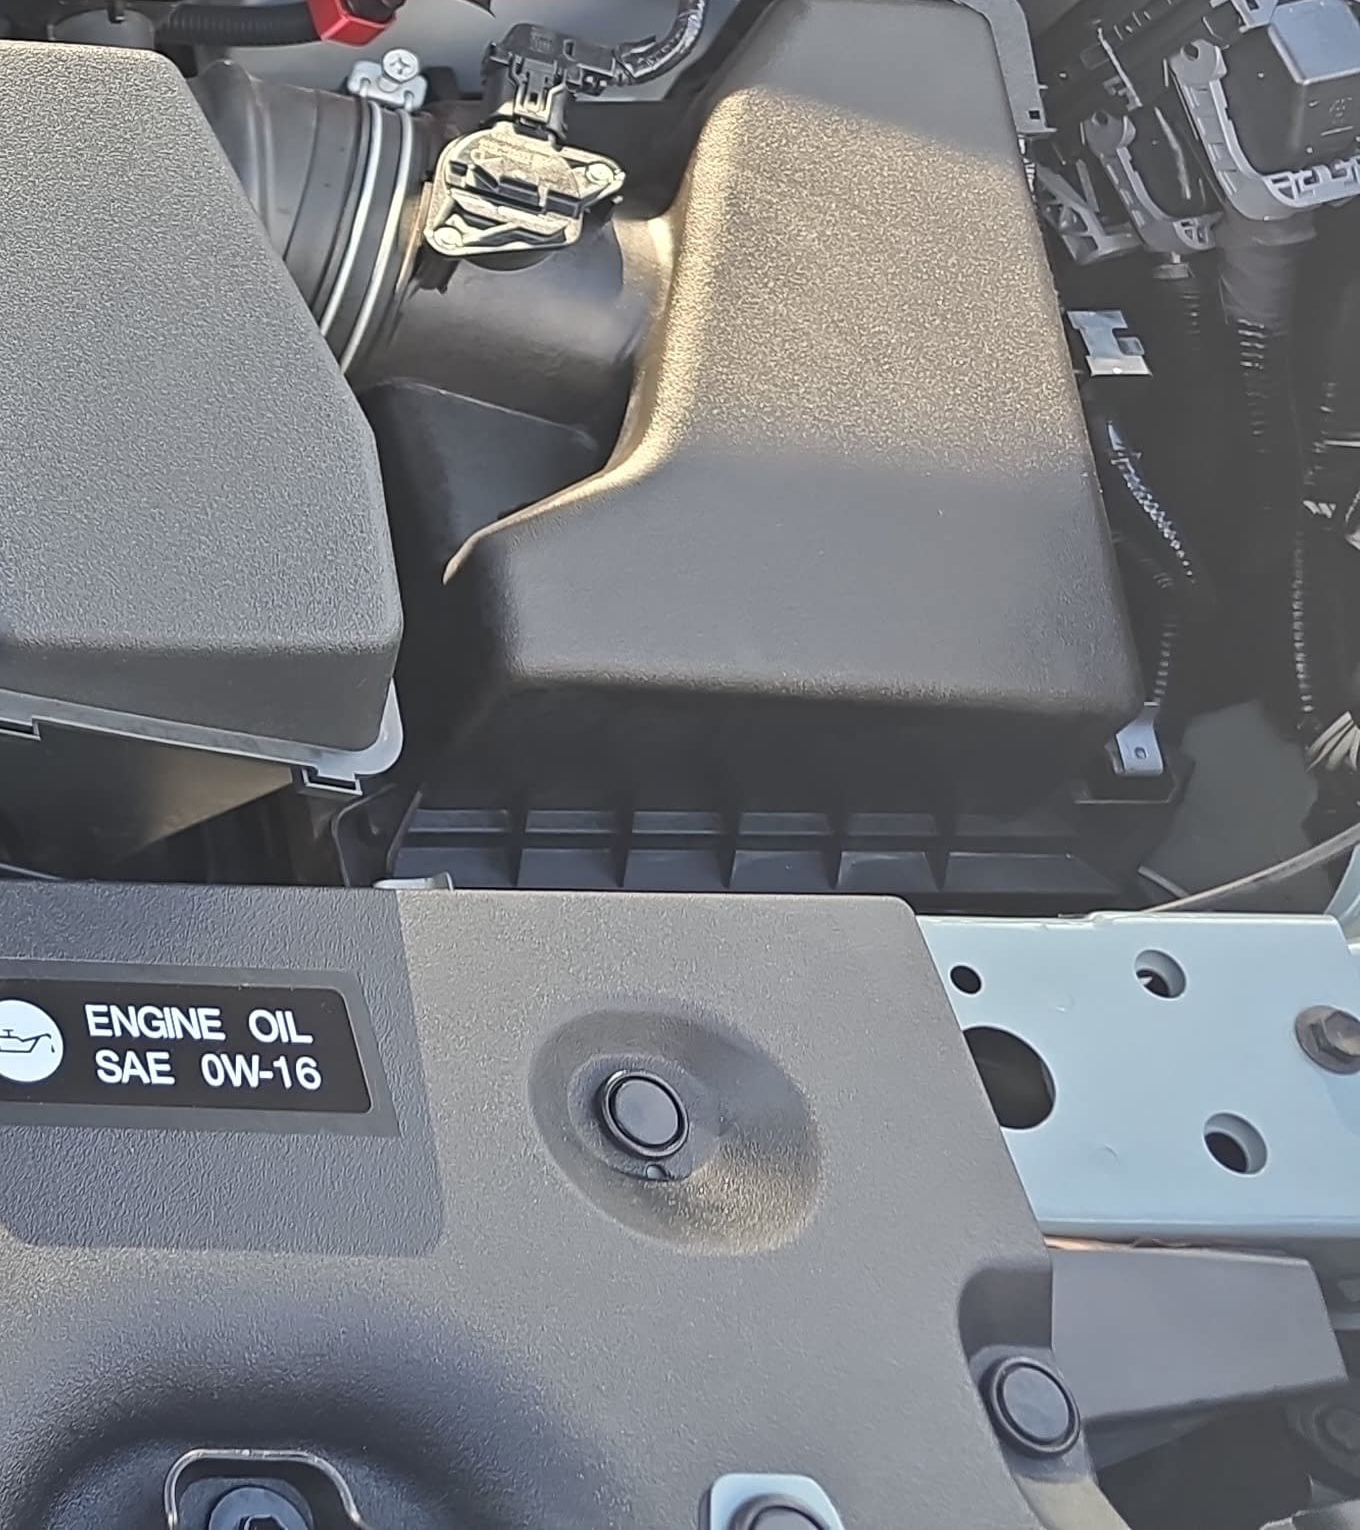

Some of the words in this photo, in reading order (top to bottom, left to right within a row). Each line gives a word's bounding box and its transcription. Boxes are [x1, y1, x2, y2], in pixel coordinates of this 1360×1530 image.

[84, 1004, 226, 1042] ENGINE
[248, 1009, 313, 1044] OIL
[95, 1051, 176, 1086] SAE
[201, 1054, 322, 1091] 0W-16
